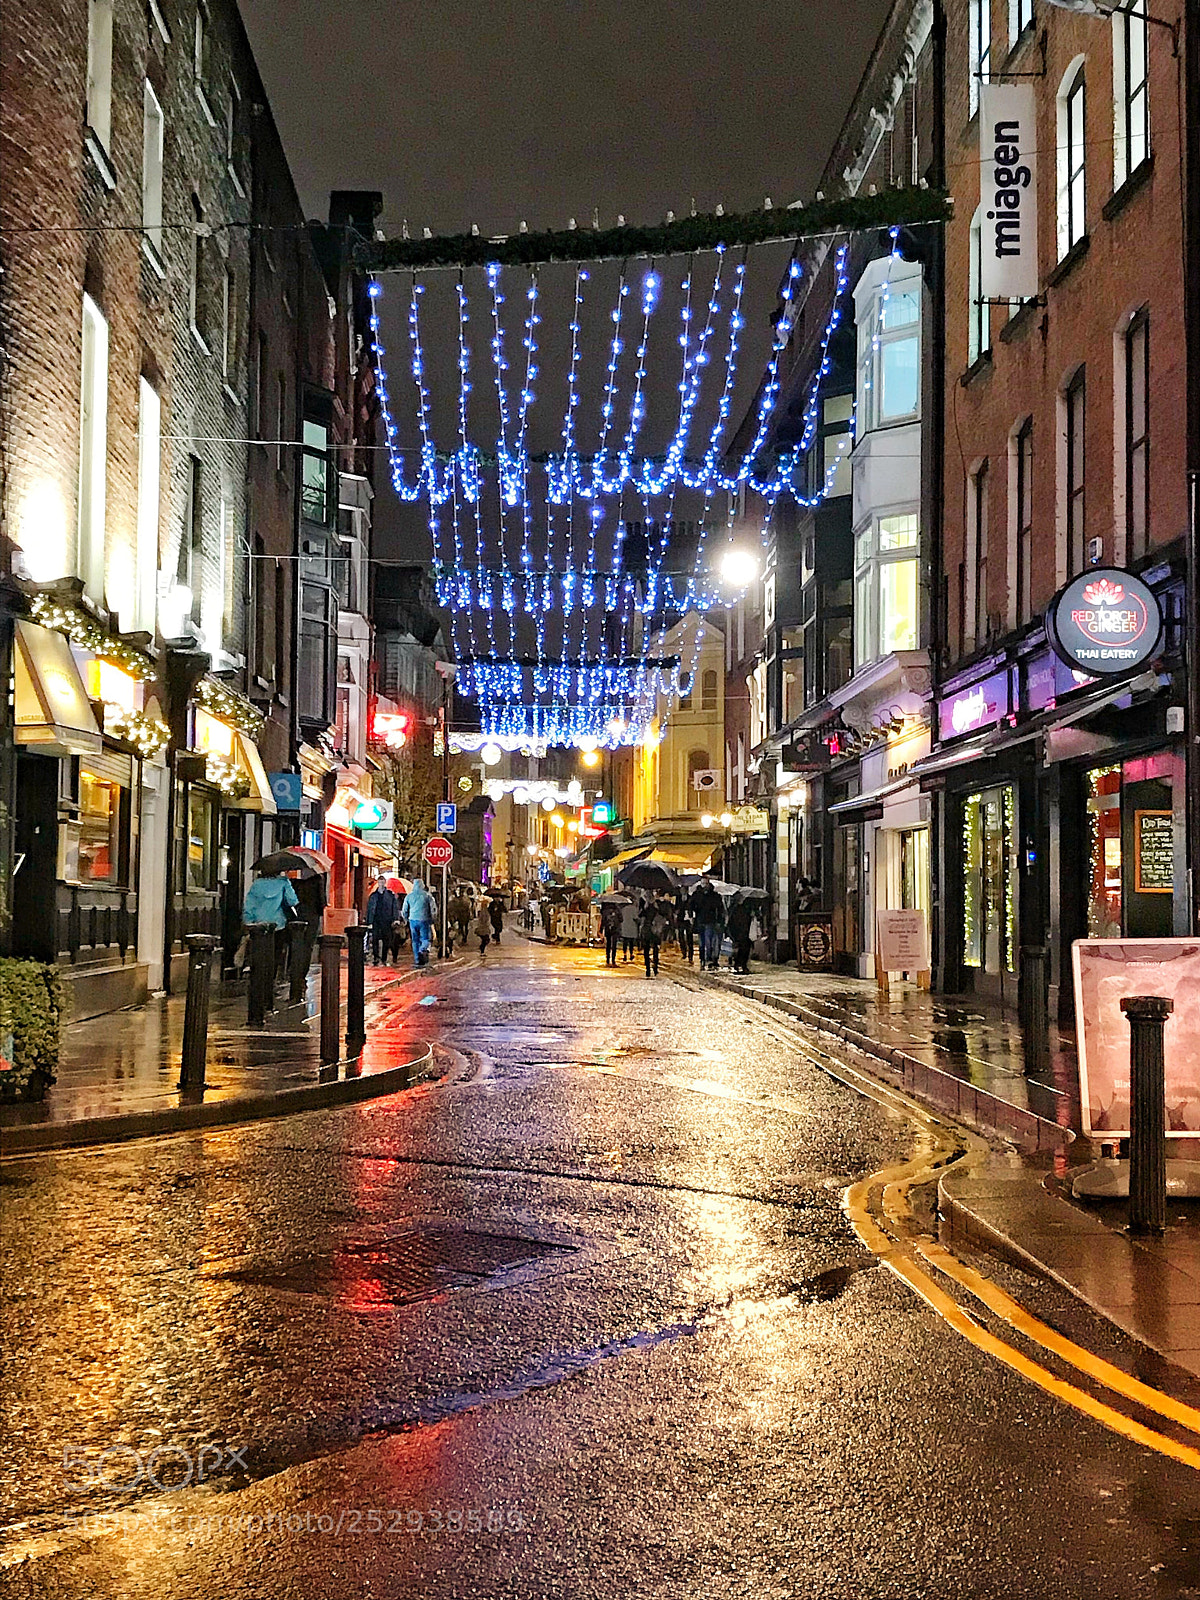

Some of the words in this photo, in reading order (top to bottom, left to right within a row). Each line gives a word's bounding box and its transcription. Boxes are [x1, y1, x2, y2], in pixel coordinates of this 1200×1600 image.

[987, 120, 1031, 259] miagen
[1071, 609, 1095, 622] RED
[1097, 606, 1137, 622] TORCH
[1087, 621, 1138, 633] GINGER
[1075, 648, 1099, 659] THAI
[1100, 649, 1138, 659] EATERY
[440, 806, 452, 821] P
[426, 847, 452, 857] STOP
